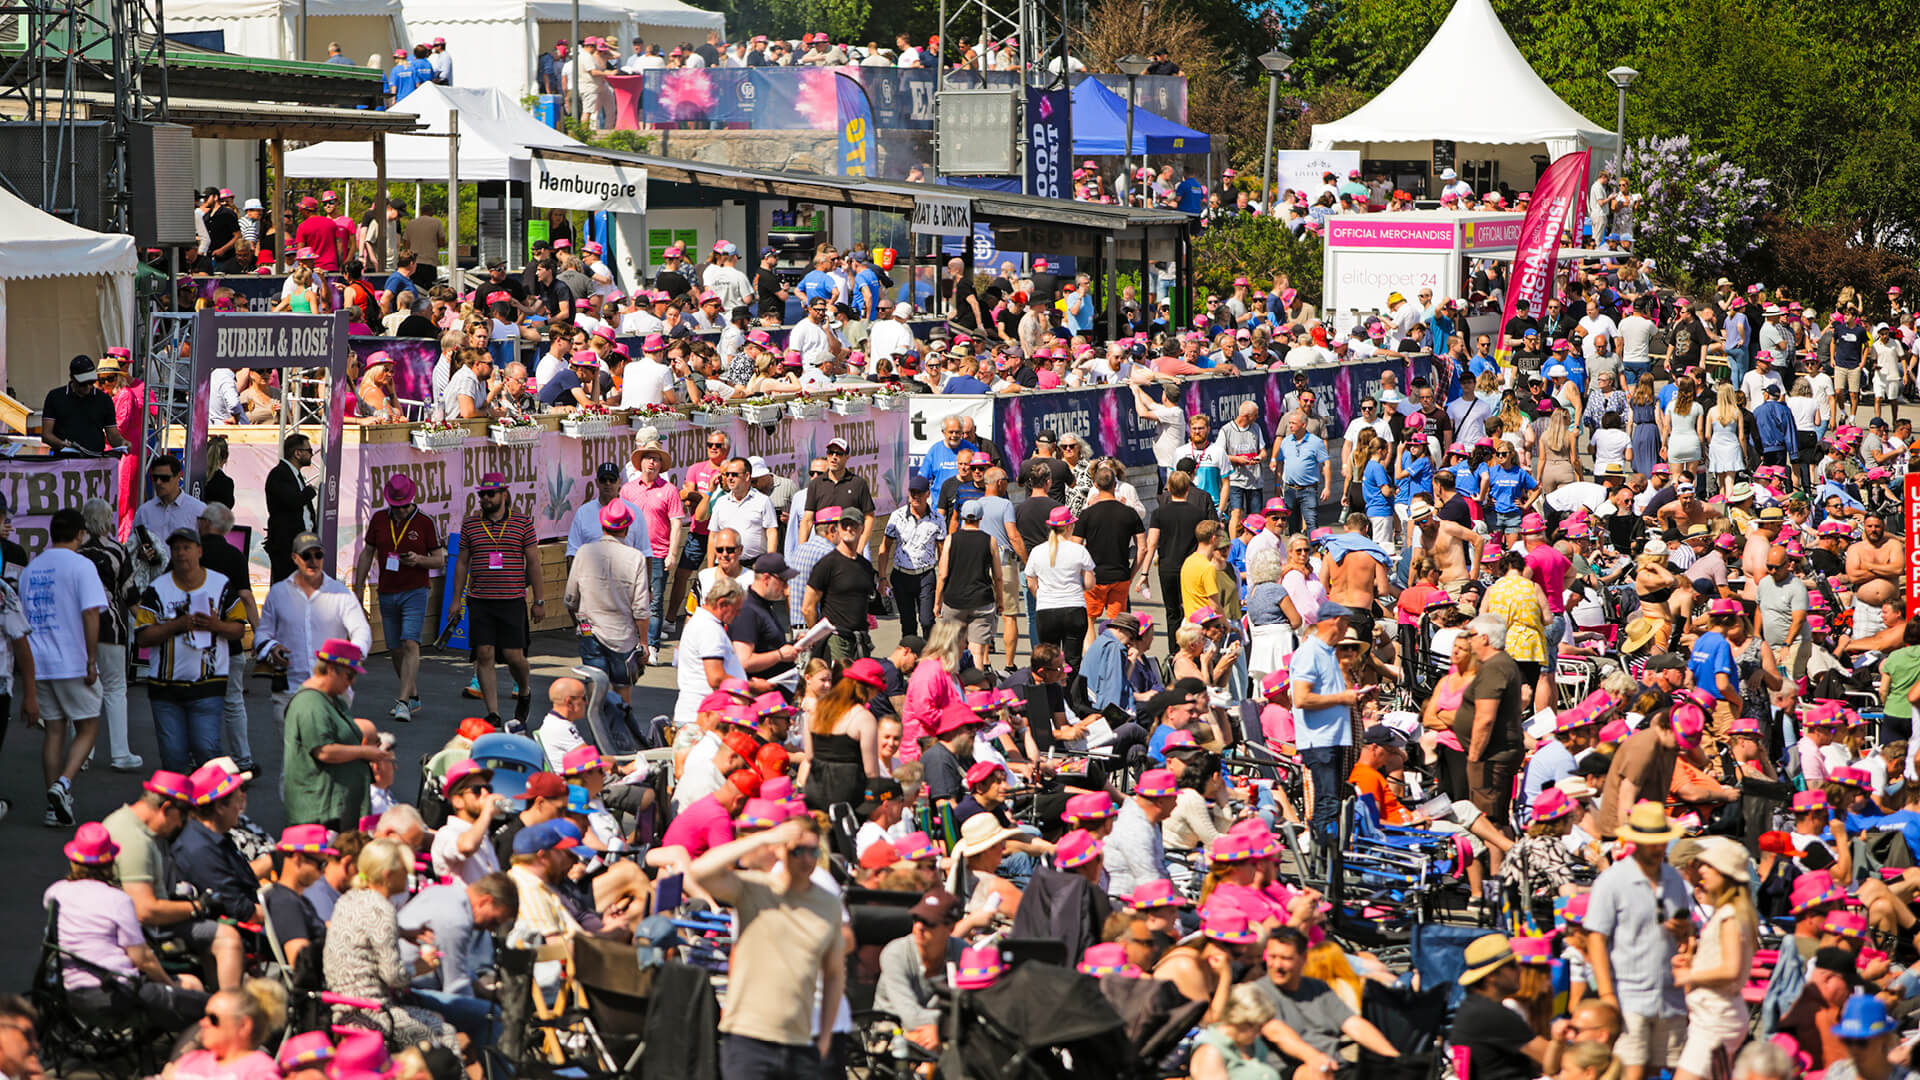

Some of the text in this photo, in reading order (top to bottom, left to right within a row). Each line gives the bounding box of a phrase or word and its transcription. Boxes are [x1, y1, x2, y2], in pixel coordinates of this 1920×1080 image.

[539, 170, 636, 201] Hamburgare
[912, 202, 968, 228] MAT & DRYCK
[1333, 228, 1452, 241] OFFICIAL MERCHANDISE
[1479, 226, 1503, 241] OFFICIAL
[1528, 196, 1566, 318] ERCHANDISE
[217, 320, 328, 358] BUBBEL & ROSÉ
